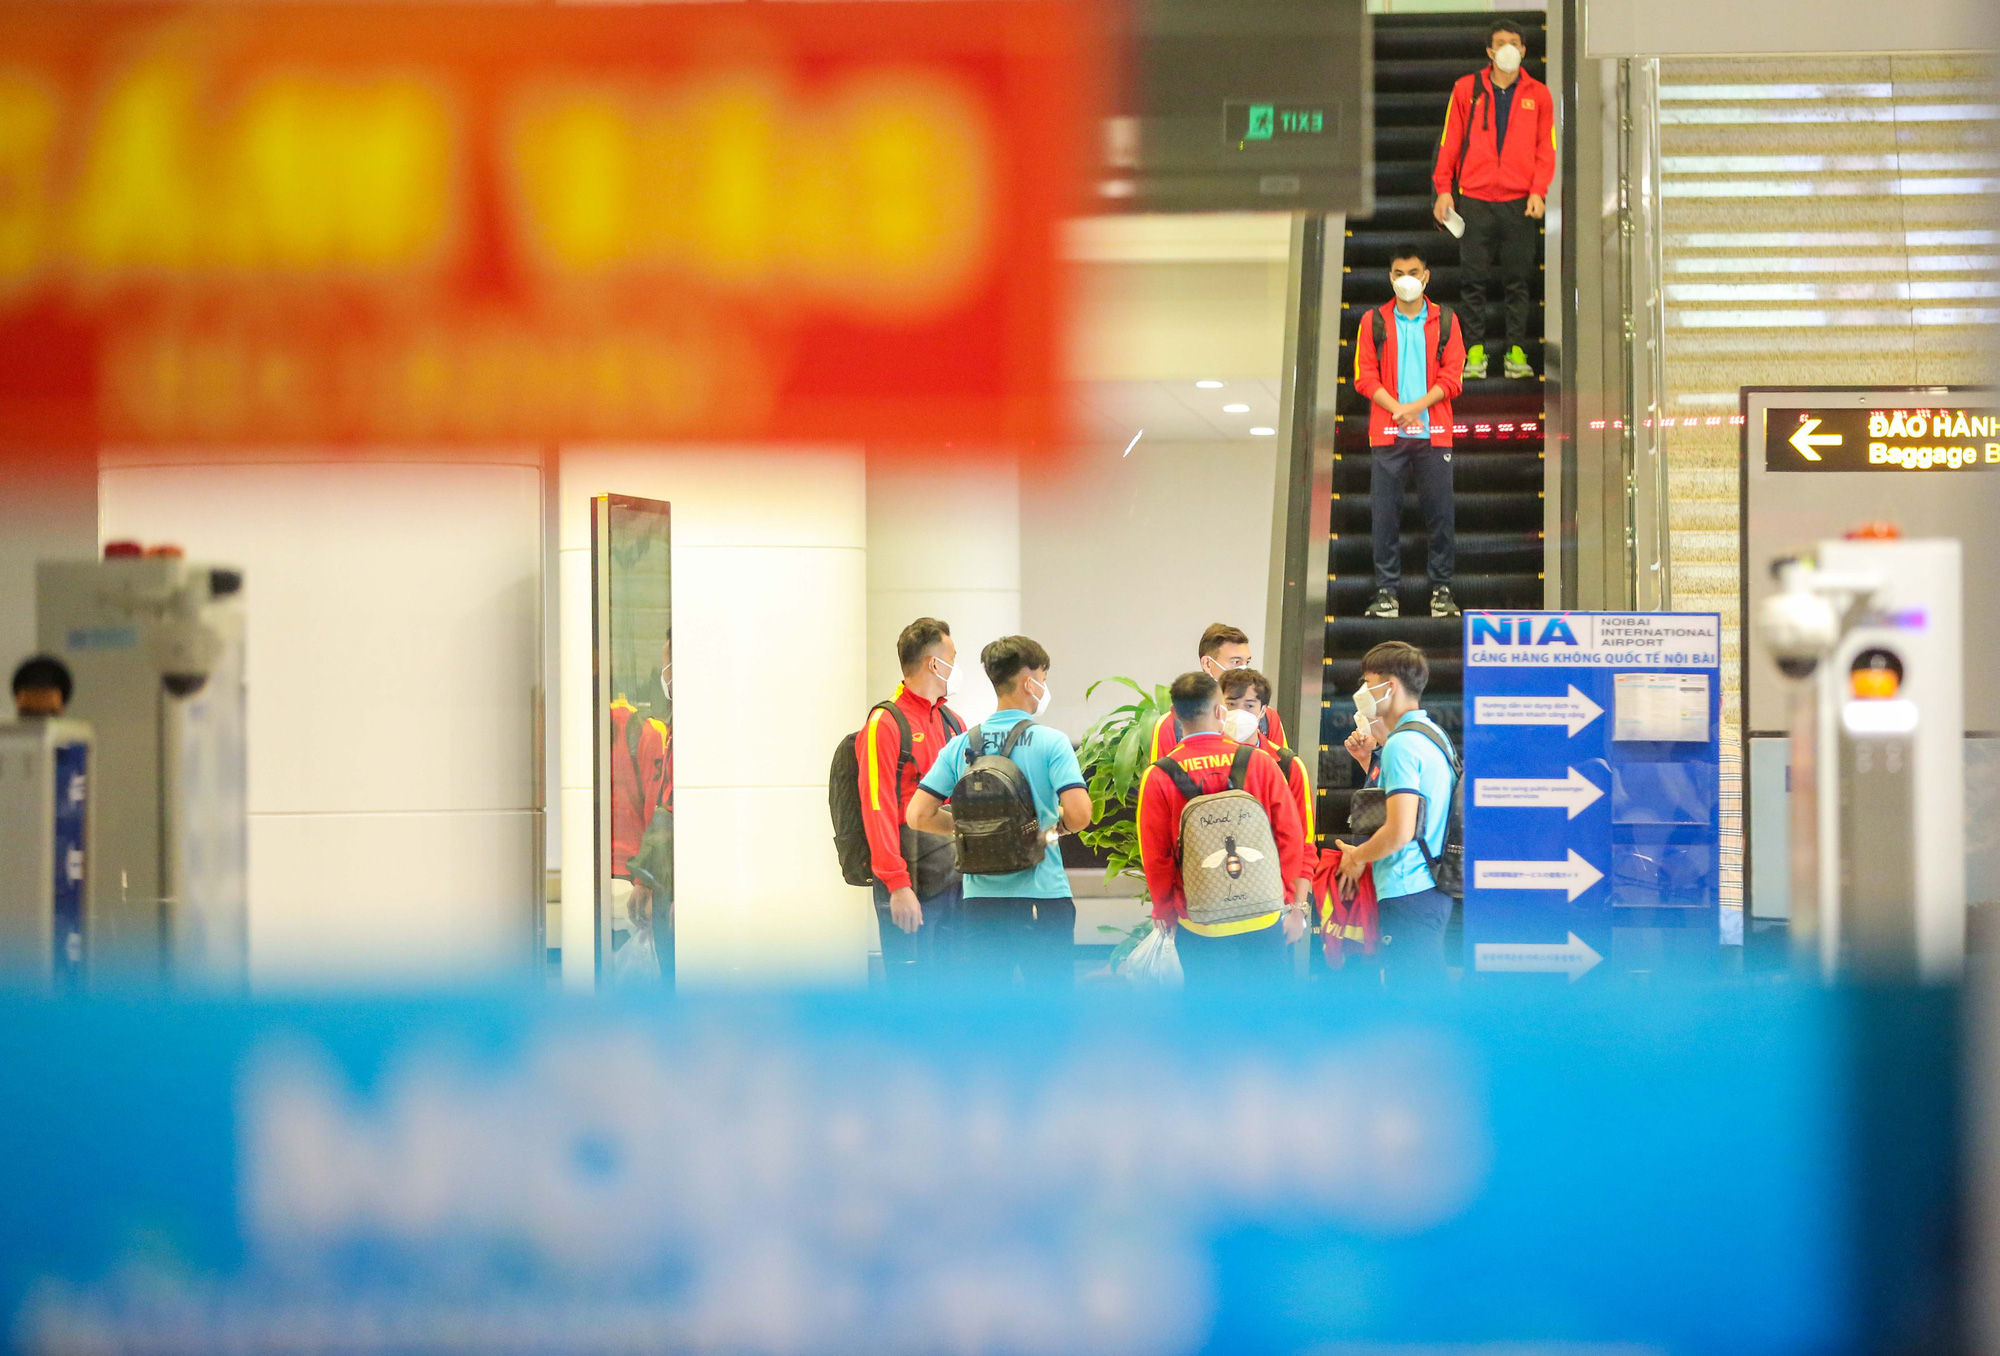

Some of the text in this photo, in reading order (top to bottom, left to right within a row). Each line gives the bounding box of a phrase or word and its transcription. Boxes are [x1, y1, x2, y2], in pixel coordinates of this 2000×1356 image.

[1869, 442, 1977, 469] Baggage
[1601, 618, 1650, 626] NOIBAI
[1471, 617, 1579, 646] NIA
[1601, 628, 1715, 637] INTERNATIONAL
[1602, 638, 1665, 647] AIRPORT
[1511, 651, 1550, 664] HÀNG
[1553, 651, 1602, 664] KHÔNG
[1605, 650, 1642, 665] QUỐC
[1645, 650, 1661, 664] TẾ
[1665, 651, 1688, 666] NỘI
[1694, 651, 1715, 664] BÀI
[1178, 753, 1236, 773] VIETNA
[1200, 809, 1252, 828] Blind for
